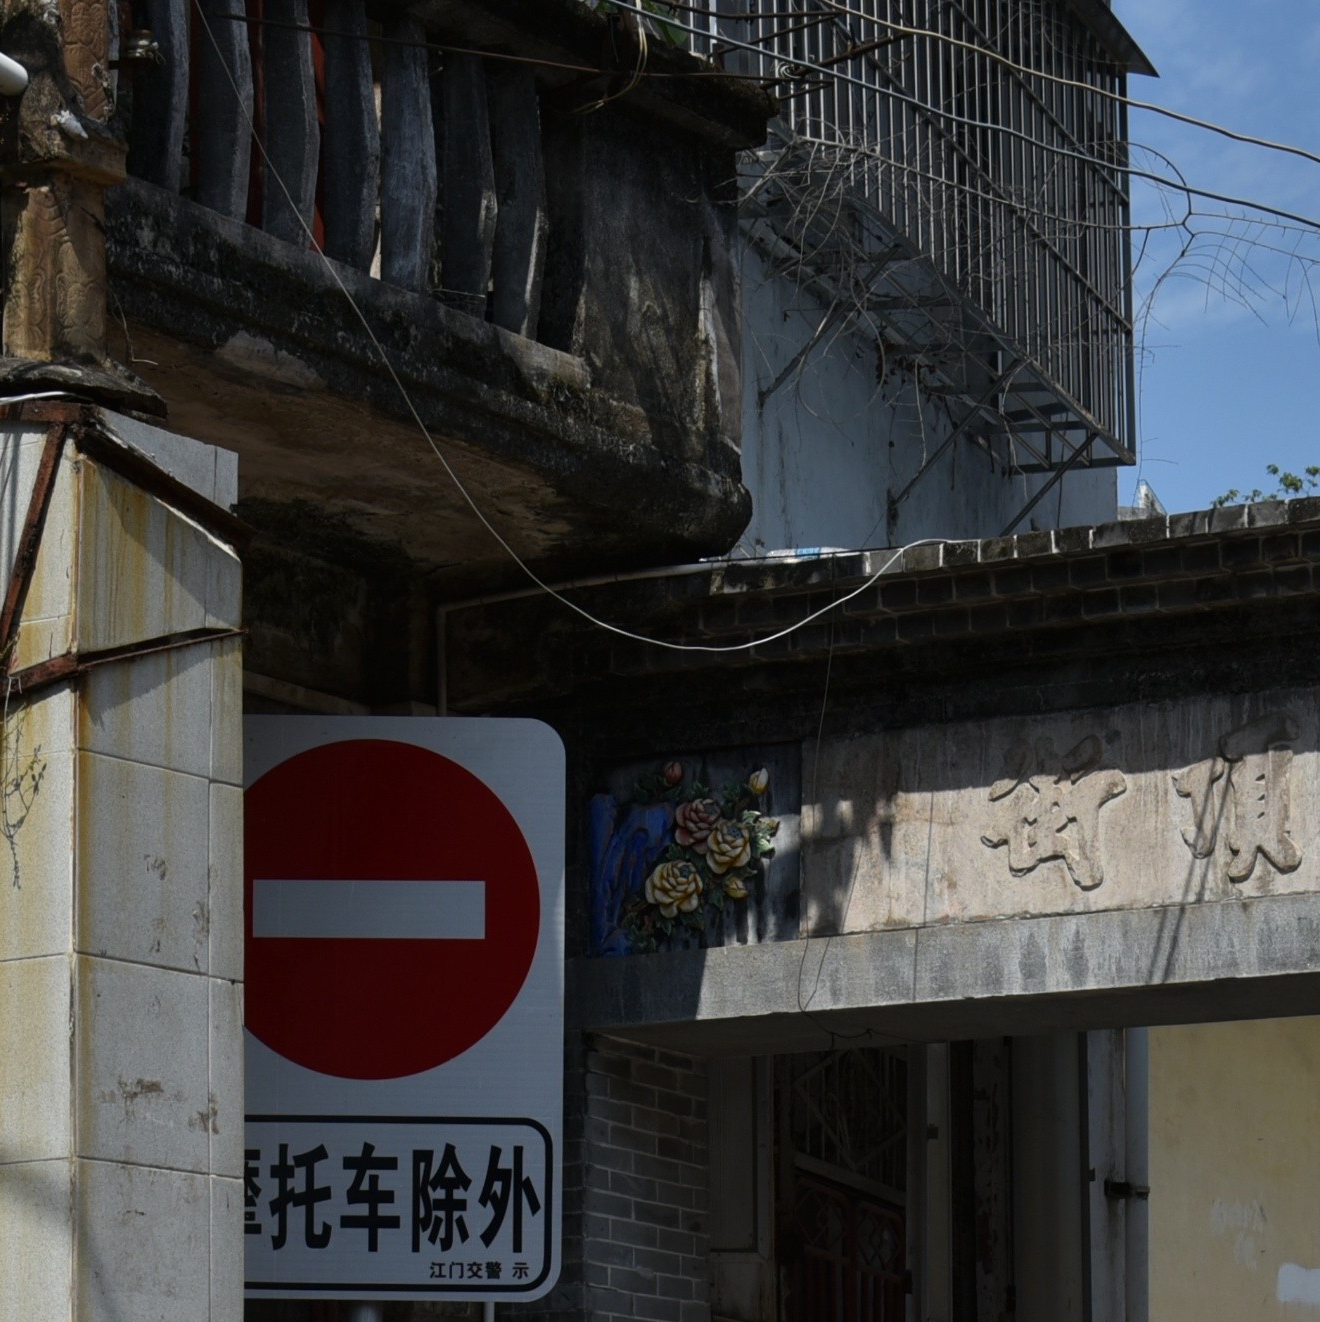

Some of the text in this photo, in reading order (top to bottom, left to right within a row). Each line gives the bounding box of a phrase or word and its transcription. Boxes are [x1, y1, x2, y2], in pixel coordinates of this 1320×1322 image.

[244, 1142, 541, 1253] 托车除外
[429, 1260, 530, 1280] 江门交警 示
